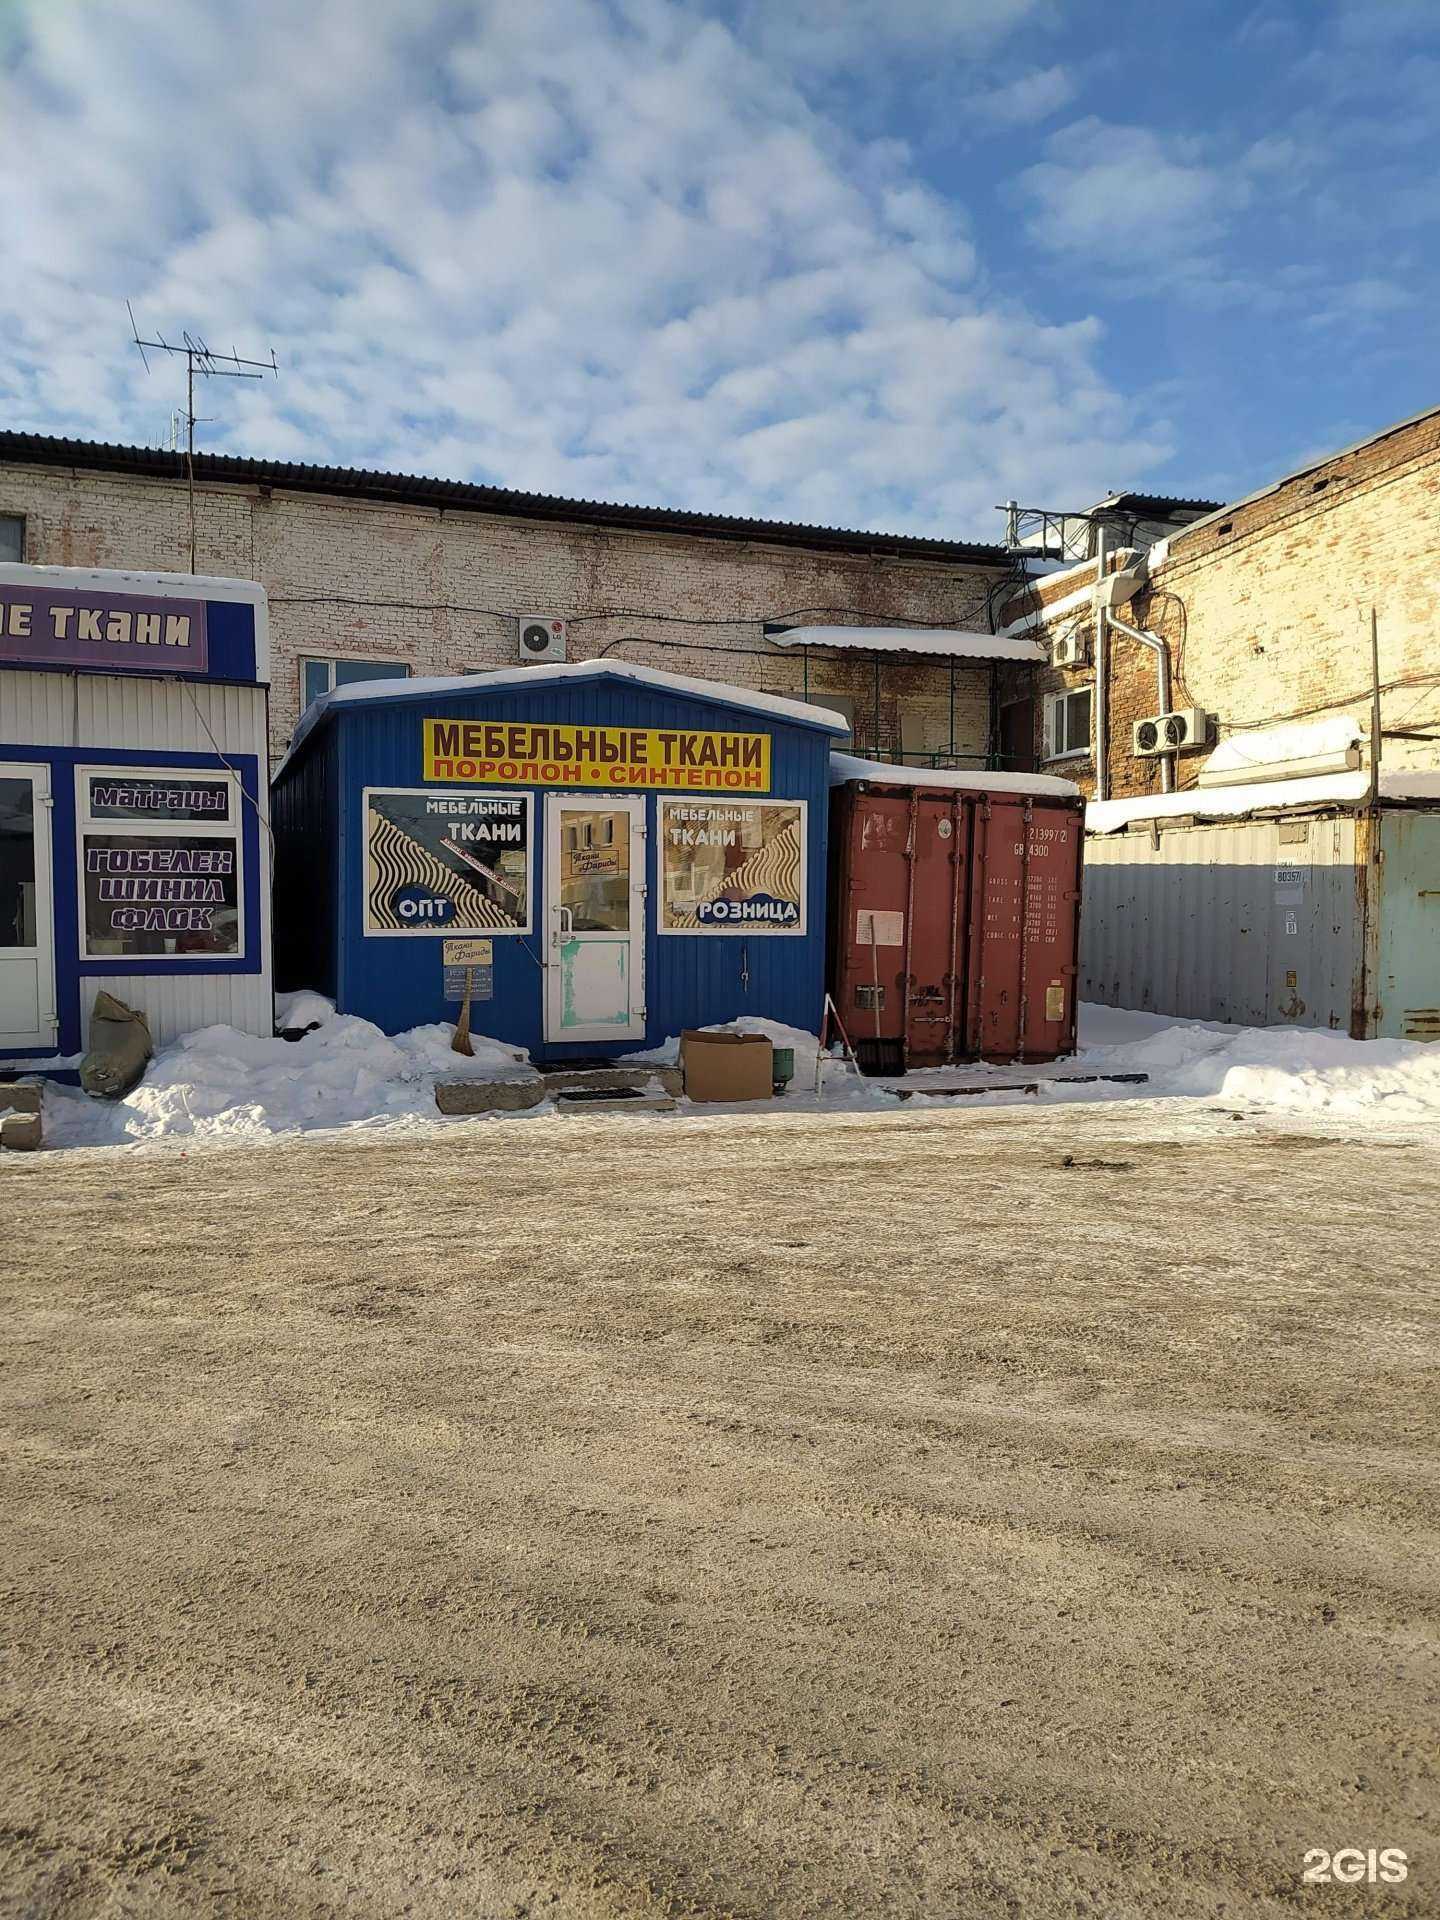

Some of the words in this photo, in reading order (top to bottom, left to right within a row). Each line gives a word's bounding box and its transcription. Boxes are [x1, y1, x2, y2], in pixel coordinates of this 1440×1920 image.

[433, 723, 648, 764] МЕБЕЛЬНЫЕ
[658, 733, 762, 768] ТКАНИ
[433, 759, 581, 782] ПОРОЛОН
[609, 766, 762, 788] СИНТЕПОН
[426, 801, 521, 815] МЕБЕЛЬНЫЕ
[669, 808, 754, 821] МЕБЕЛЬНЫЕ
[447, 822, 521, 841] ТКАНИ
[670, 828, 736, 846] ТКАНИ
[1029, 844, 1049, 856] 4300
[87, 849, 232, 873] ГОБЕЛЕН
[99, 878, 226, 902] ШИНИЛ
[399, 899, 448, 917] ОПТ
[699, 901, 798, 920] РОЗНИЦА
[111, 907, 214, 931] ФЛОК
